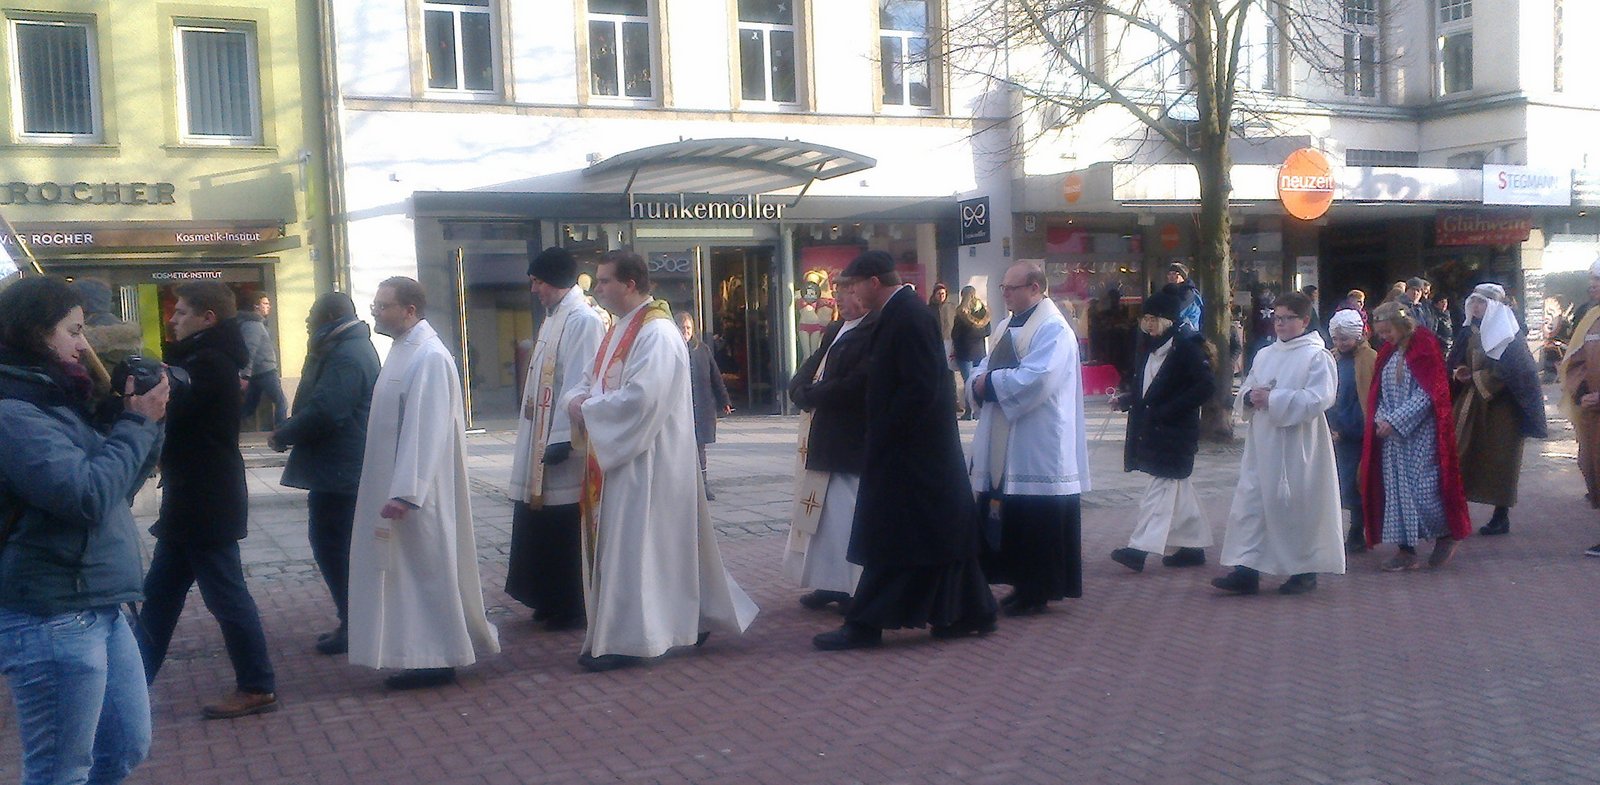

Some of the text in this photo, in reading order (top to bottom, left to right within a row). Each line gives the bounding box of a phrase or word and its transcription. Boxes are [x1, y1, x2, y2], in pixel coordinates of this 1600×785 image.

[1281, 175, 1334, 189] neuzeit
[8, 181, 176, 205] ROCHER
[32, 233, 94, 245] ROCHER
[176, 232, 261, 242] Kosmetik-Institut
[152, 271, 222, 279] KOSMETIK-INSTITUT
